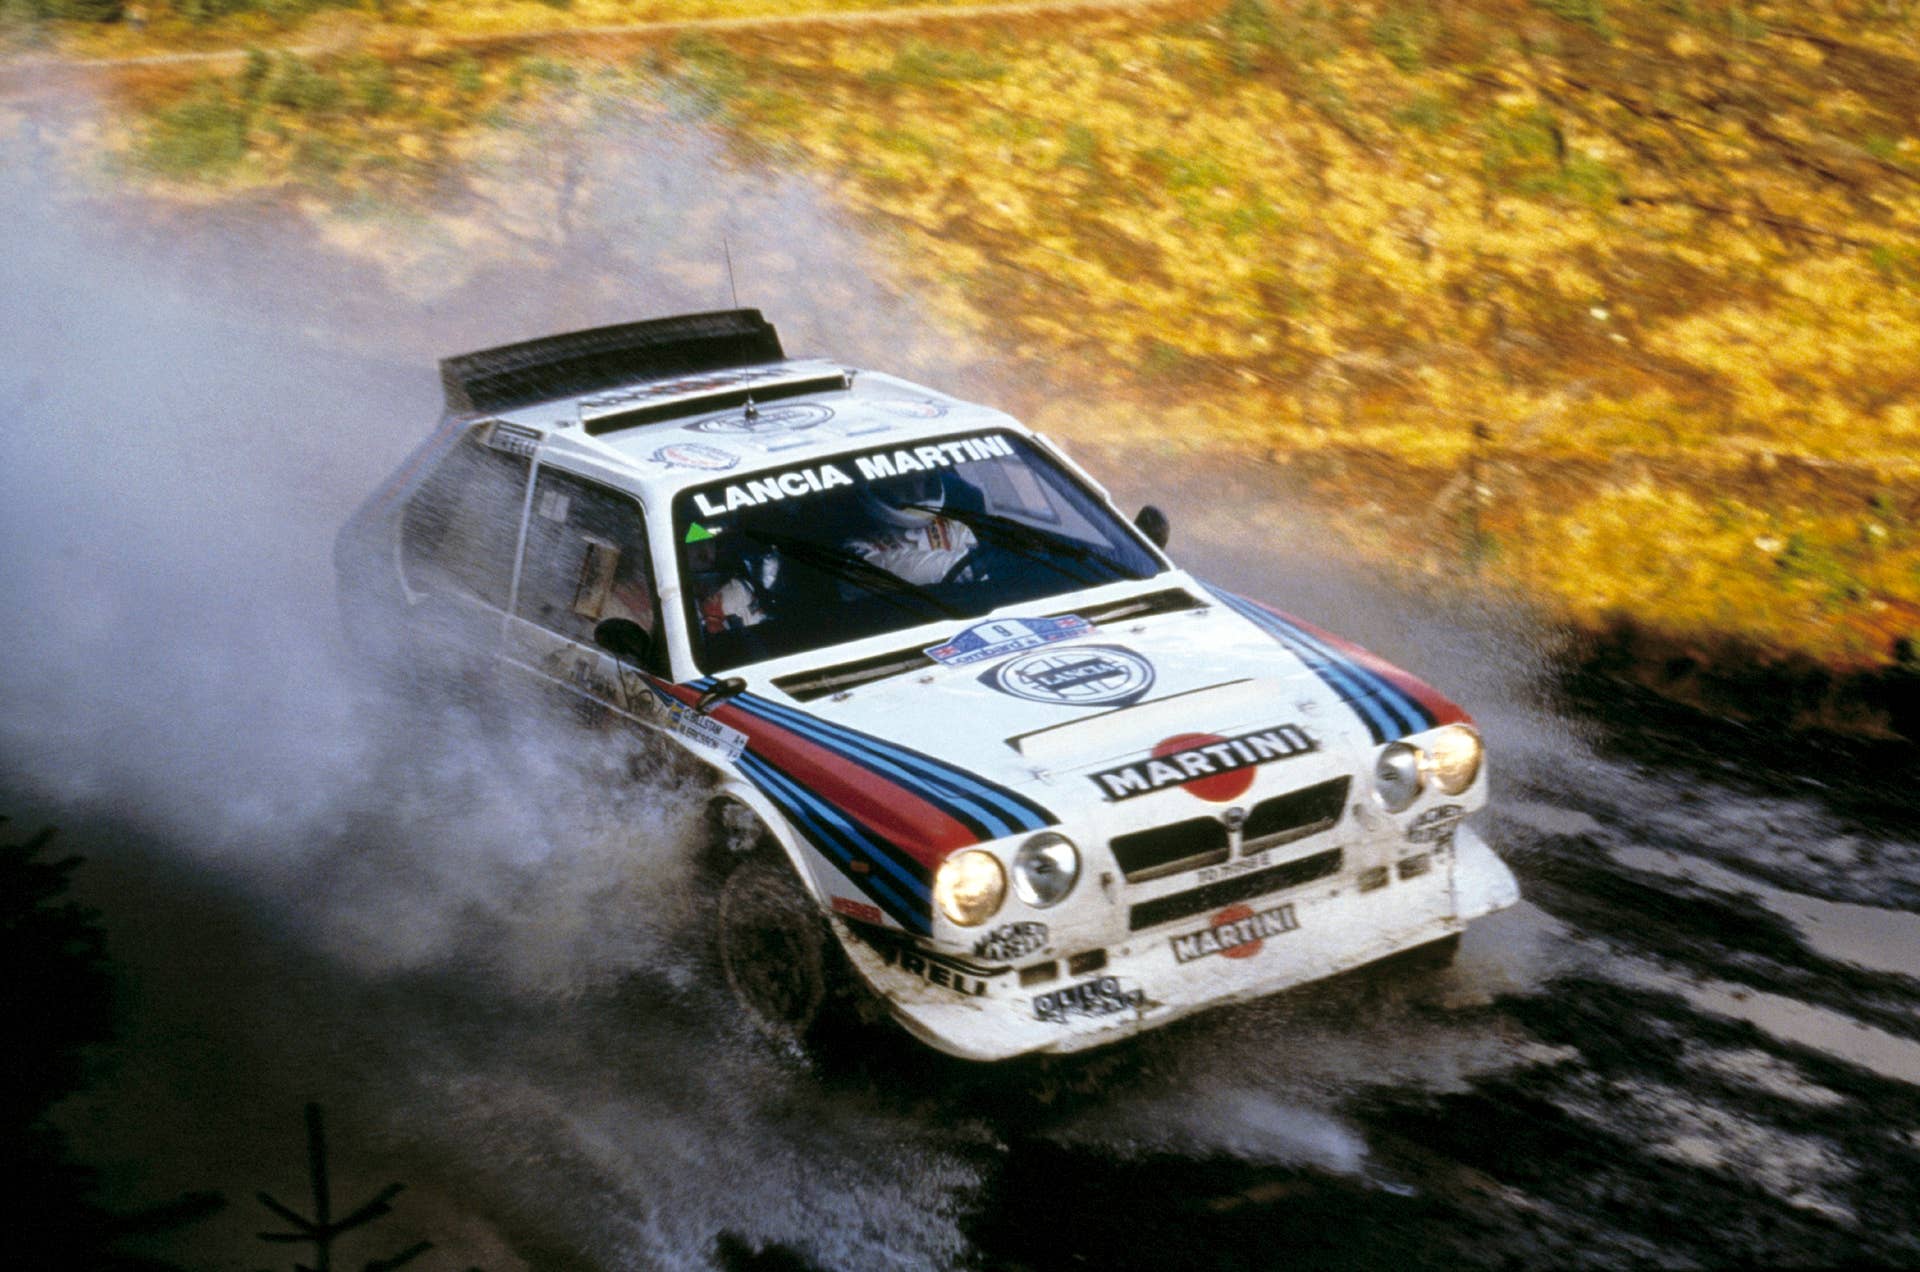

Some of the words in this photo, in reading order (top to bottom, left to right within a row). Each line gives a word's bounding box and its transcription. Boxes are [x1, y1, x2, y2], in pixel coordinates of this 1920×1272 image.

[694, 465, 853, 517] LANCIA
[854, 434, 1015, 481] MARTINI
[1038, 663, 1117, 686] LANCIA
[1101, 728, 1310, 797] MARTINI
[1175, 907, 1296, 961] MARTINI
